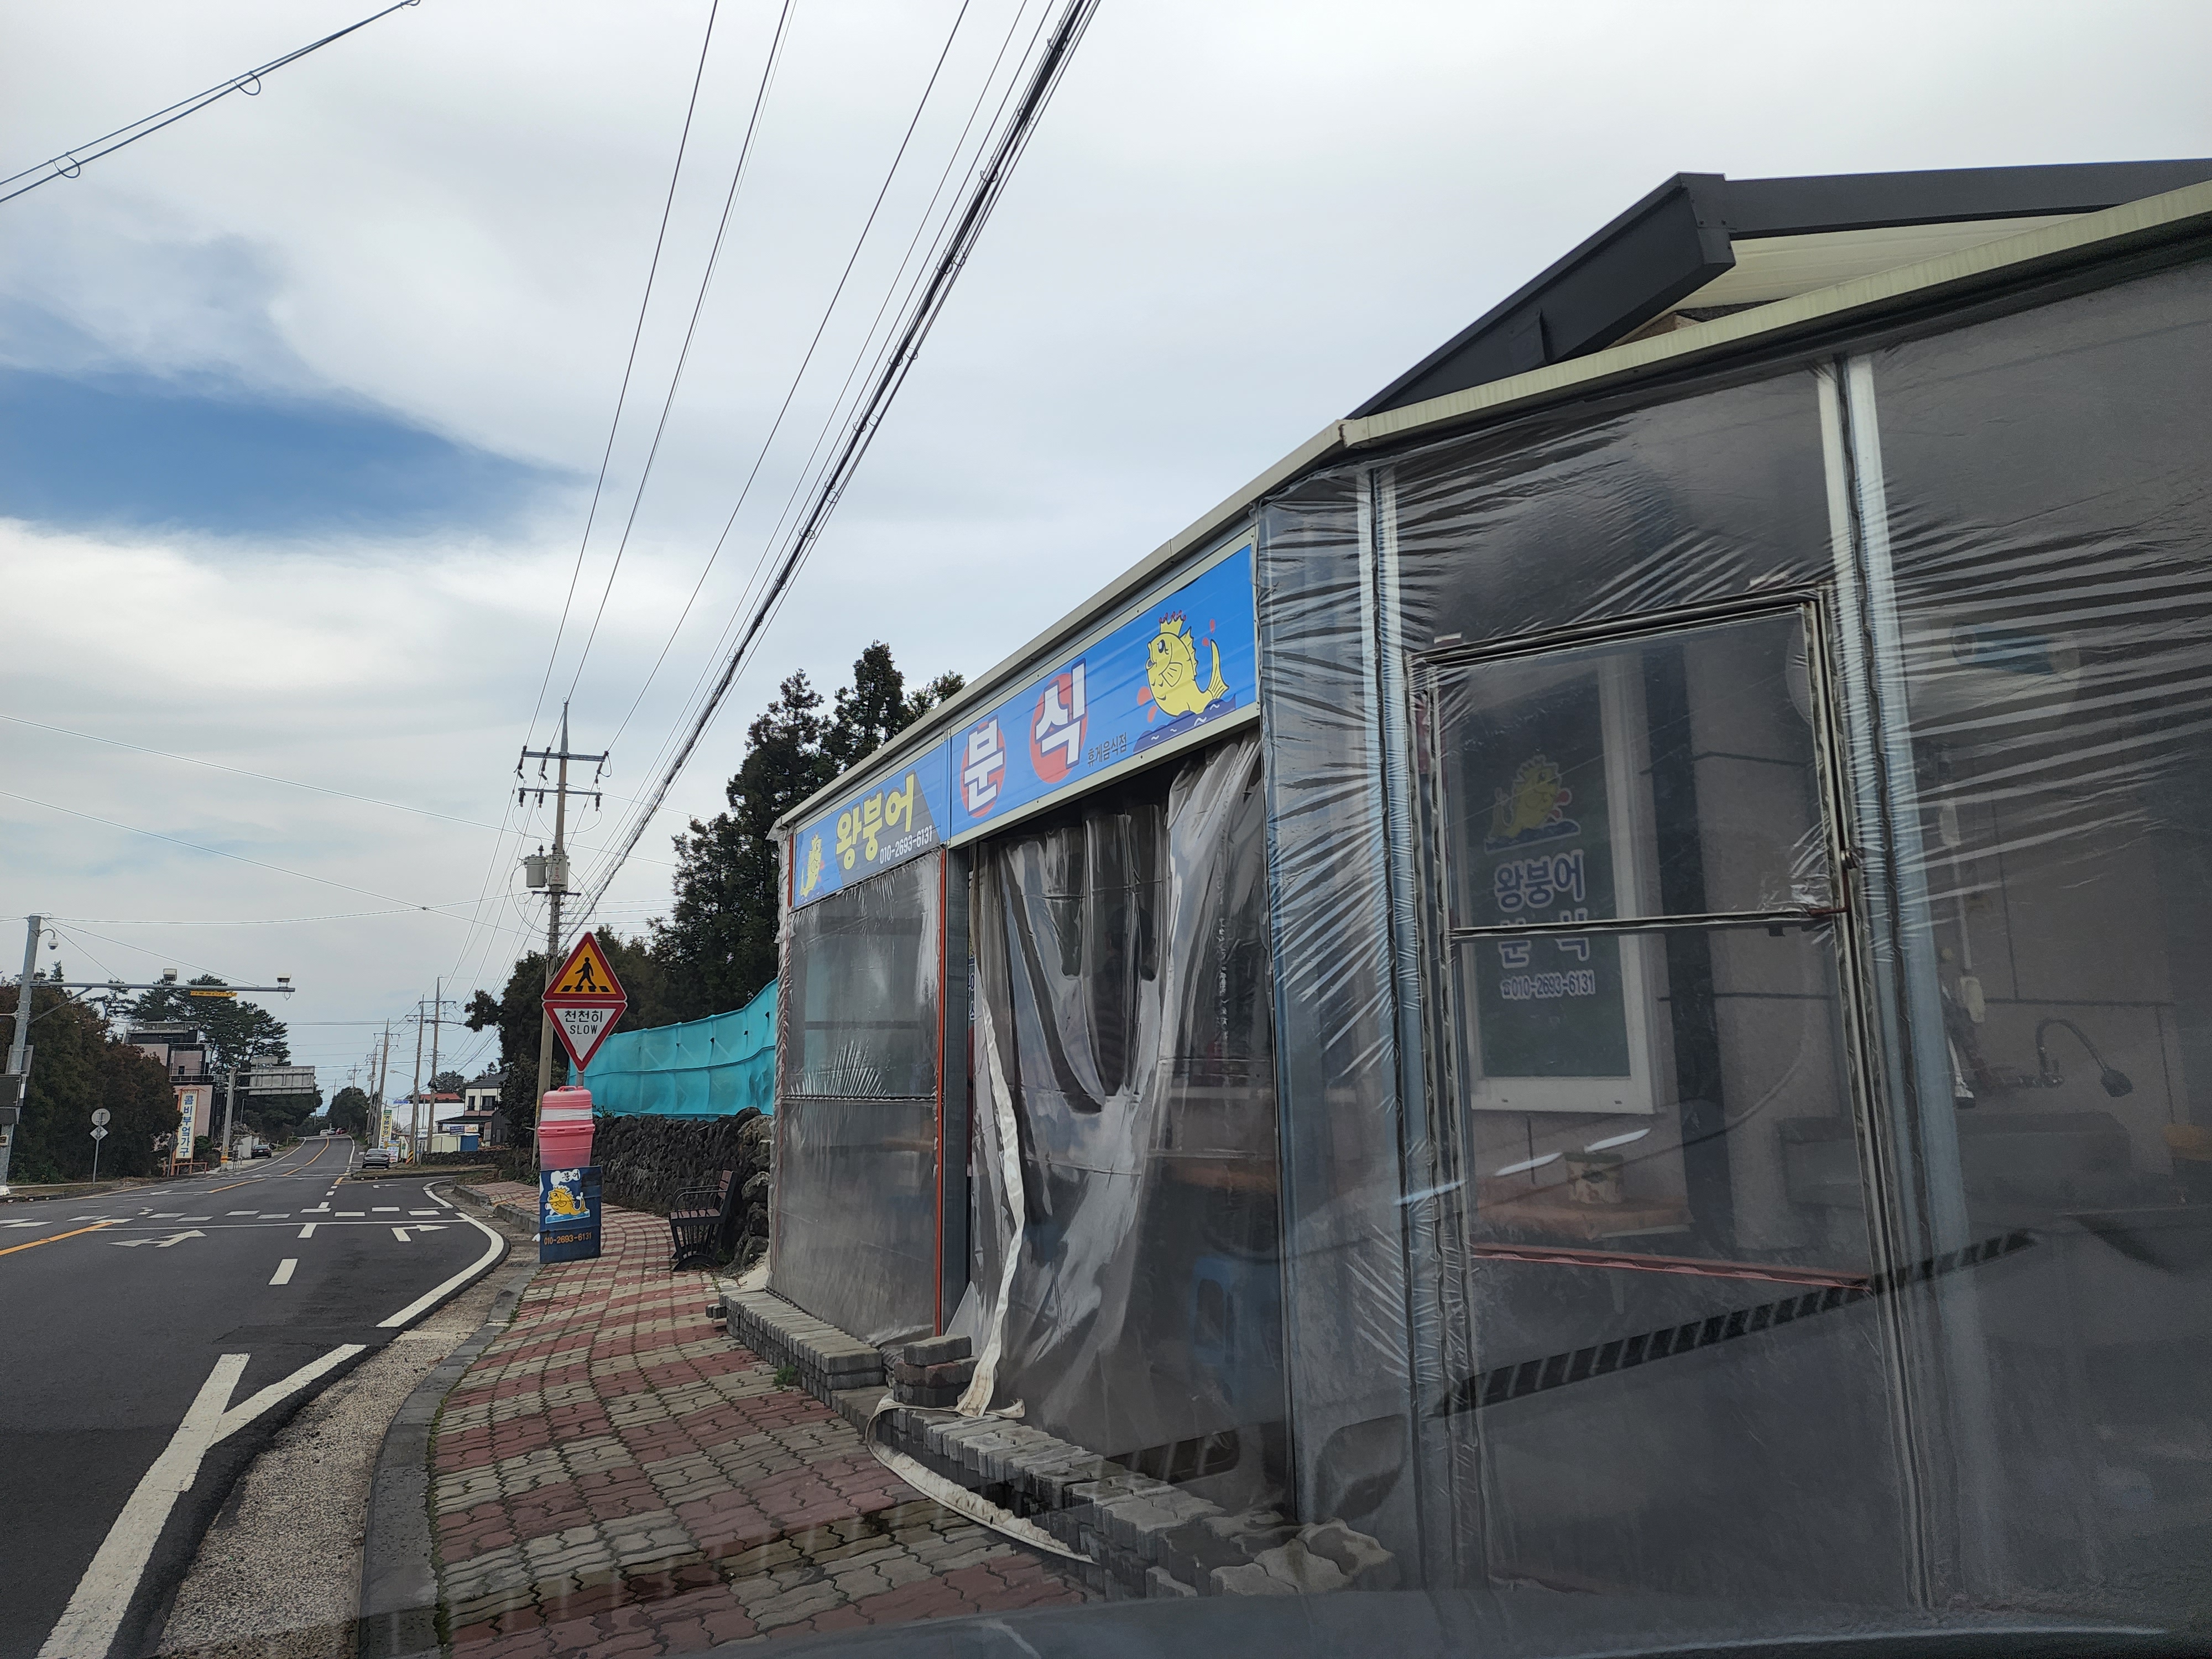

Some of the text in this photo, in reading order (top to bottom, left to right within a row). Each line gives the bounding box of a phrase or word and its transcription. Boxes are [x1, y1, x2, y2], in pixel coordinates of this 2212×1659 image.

[1087, 732, 1127, 768] 휴게음식점
[836, 774, 914, 870] 왕붕어
[879, 825, 933, 865] 010-2693-6131
[1495, 851, 1585, 911] 왕붕어
[565, 1010, 603, 1023] 천천히
[570, 1025, 598, 1035] SLOW
[179, 1095, 194, 1157] 콤비부엌가구
[562, 1170, 579, 1181] 붕어
[544, 1232, 592, 1245] 010-2693-6131
